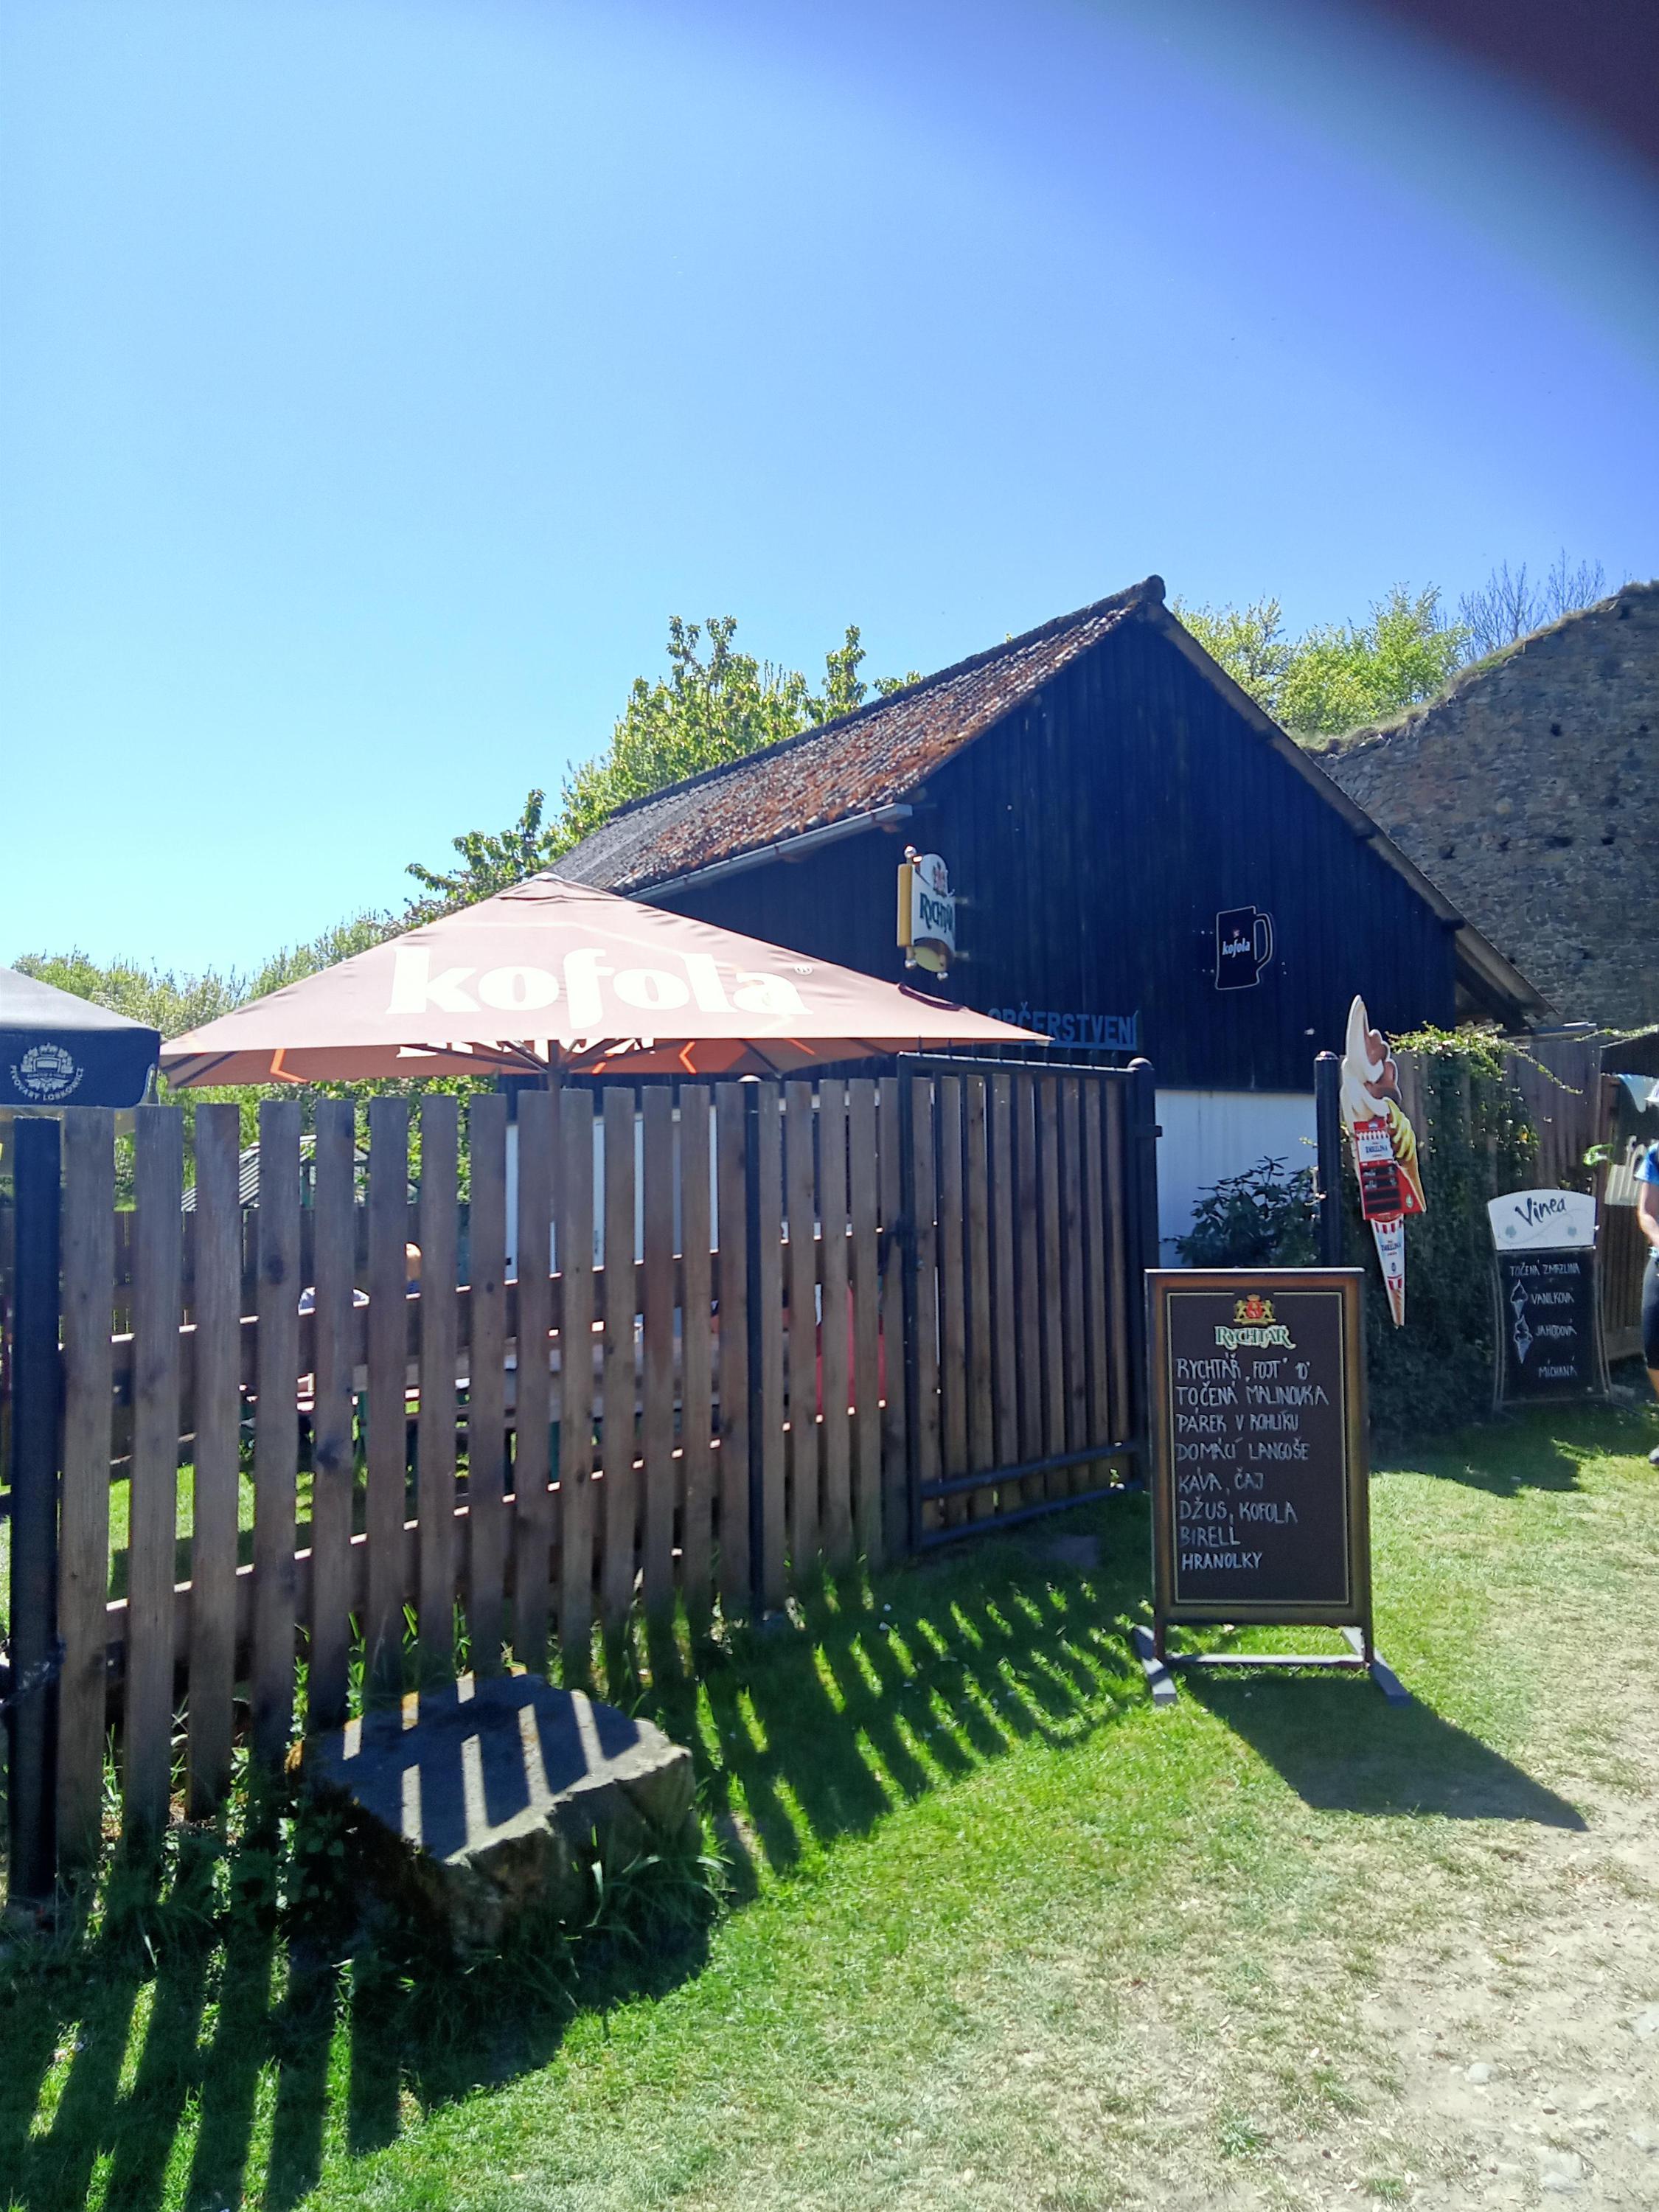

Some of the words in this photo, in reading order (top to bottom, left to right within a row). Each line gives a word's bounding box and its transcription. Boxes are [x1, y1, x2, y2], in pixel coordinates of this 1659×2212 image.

[1222, 937, 1251, 958] kofola
[385, 946, 814, 1029] kofola
[1515, 1196, 1566, 1226] Vinea
[1176, 1352, 1242, 1380] RYCHTÁŘ
[1176, 1380, 1239, 1407] TOČENÁ
[1245, 1385, 1330, 1406] MALINOVKA
[1176, 1407, 1228, 1433] PÁREK
[1235, 1413, 1245, 1431] V
[1249, 1409, 1299, 1432] ROHLÍKU
[1175, 1437, 1244, 1462] DOMÁCÍ
[1248, 1436, 1310, 1461] LANGOŠE
[1234, 1466, 1265, 1491] ČAJ
[1238, 1500, 1298, 1525] KOFOLA
[1180, 1525, 1242, 1548] BIRELL
[1181, 1551, 1264, 1572] HRANOLKY
